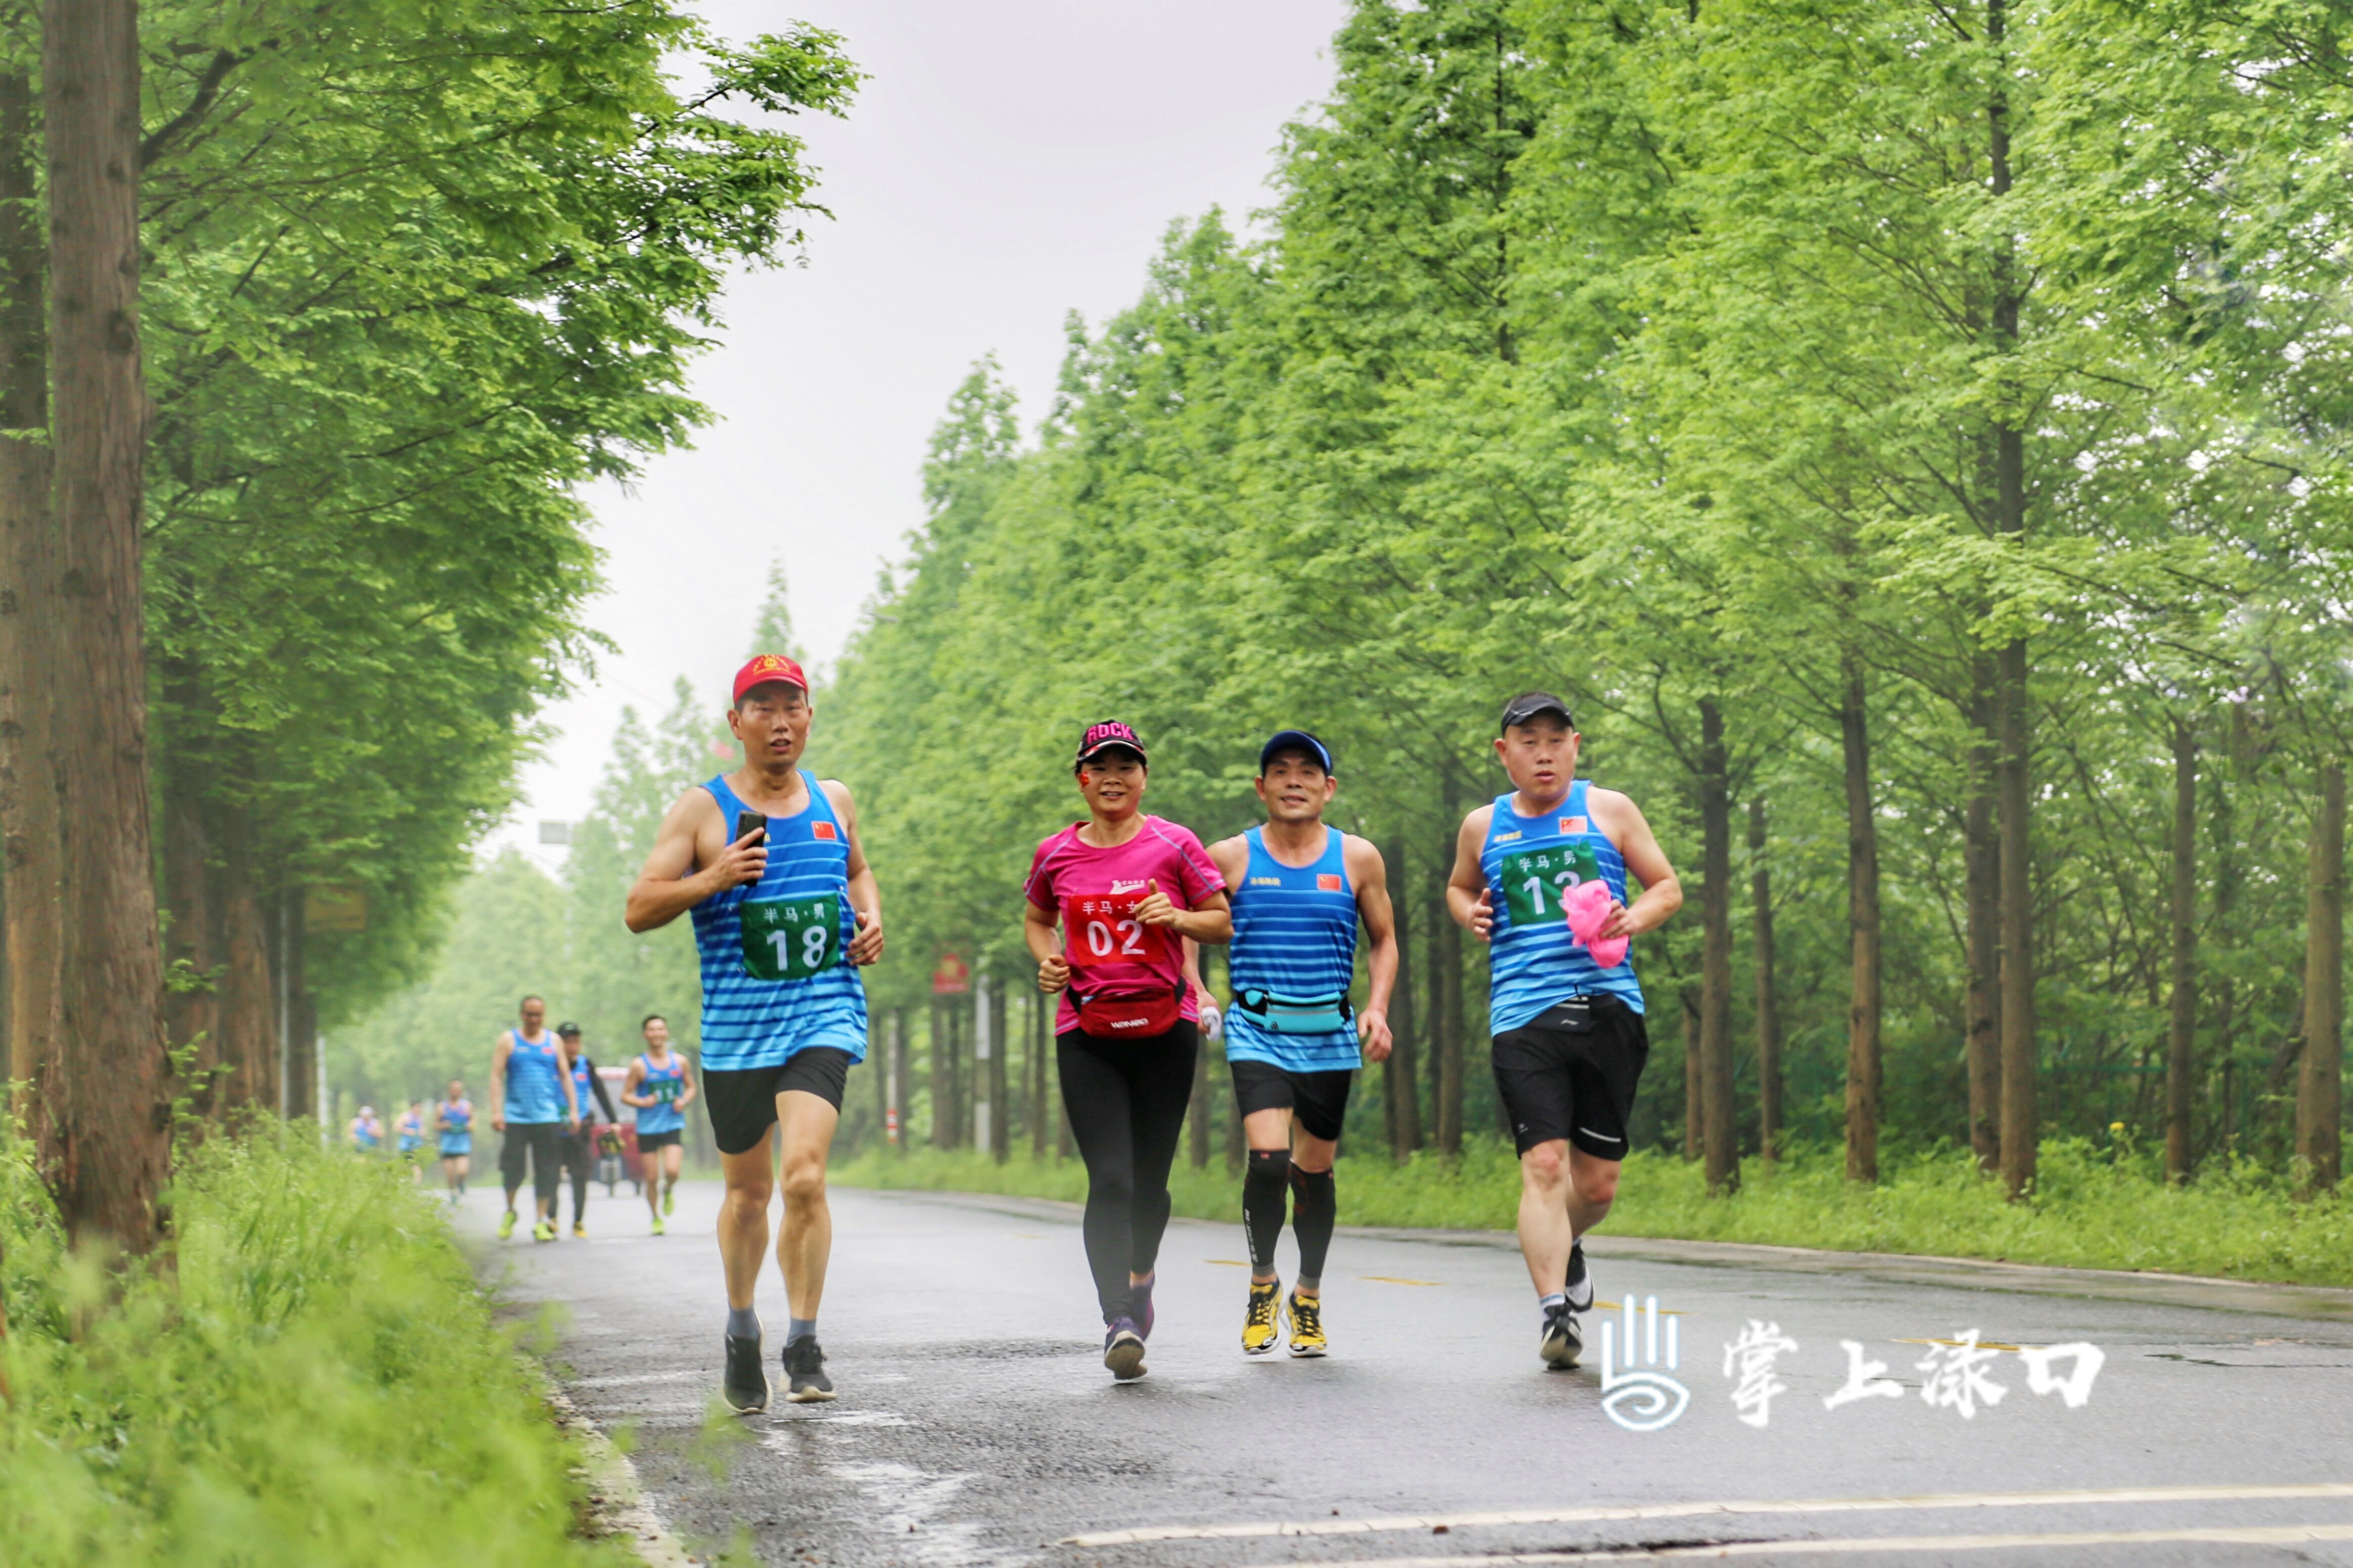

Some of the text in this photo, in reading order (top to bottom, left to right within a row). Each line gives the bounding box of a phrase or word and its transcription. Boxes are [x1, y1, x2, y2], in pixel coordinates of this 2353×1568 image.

[1087, 722, 1135, 745] ROCK
[1518, 850, 1576, 873] 半马·男
[763, 902, 825, 925] 半马·男
[766, 925, 827, 972] 18
[1087, 919, 1146, 956] 02
